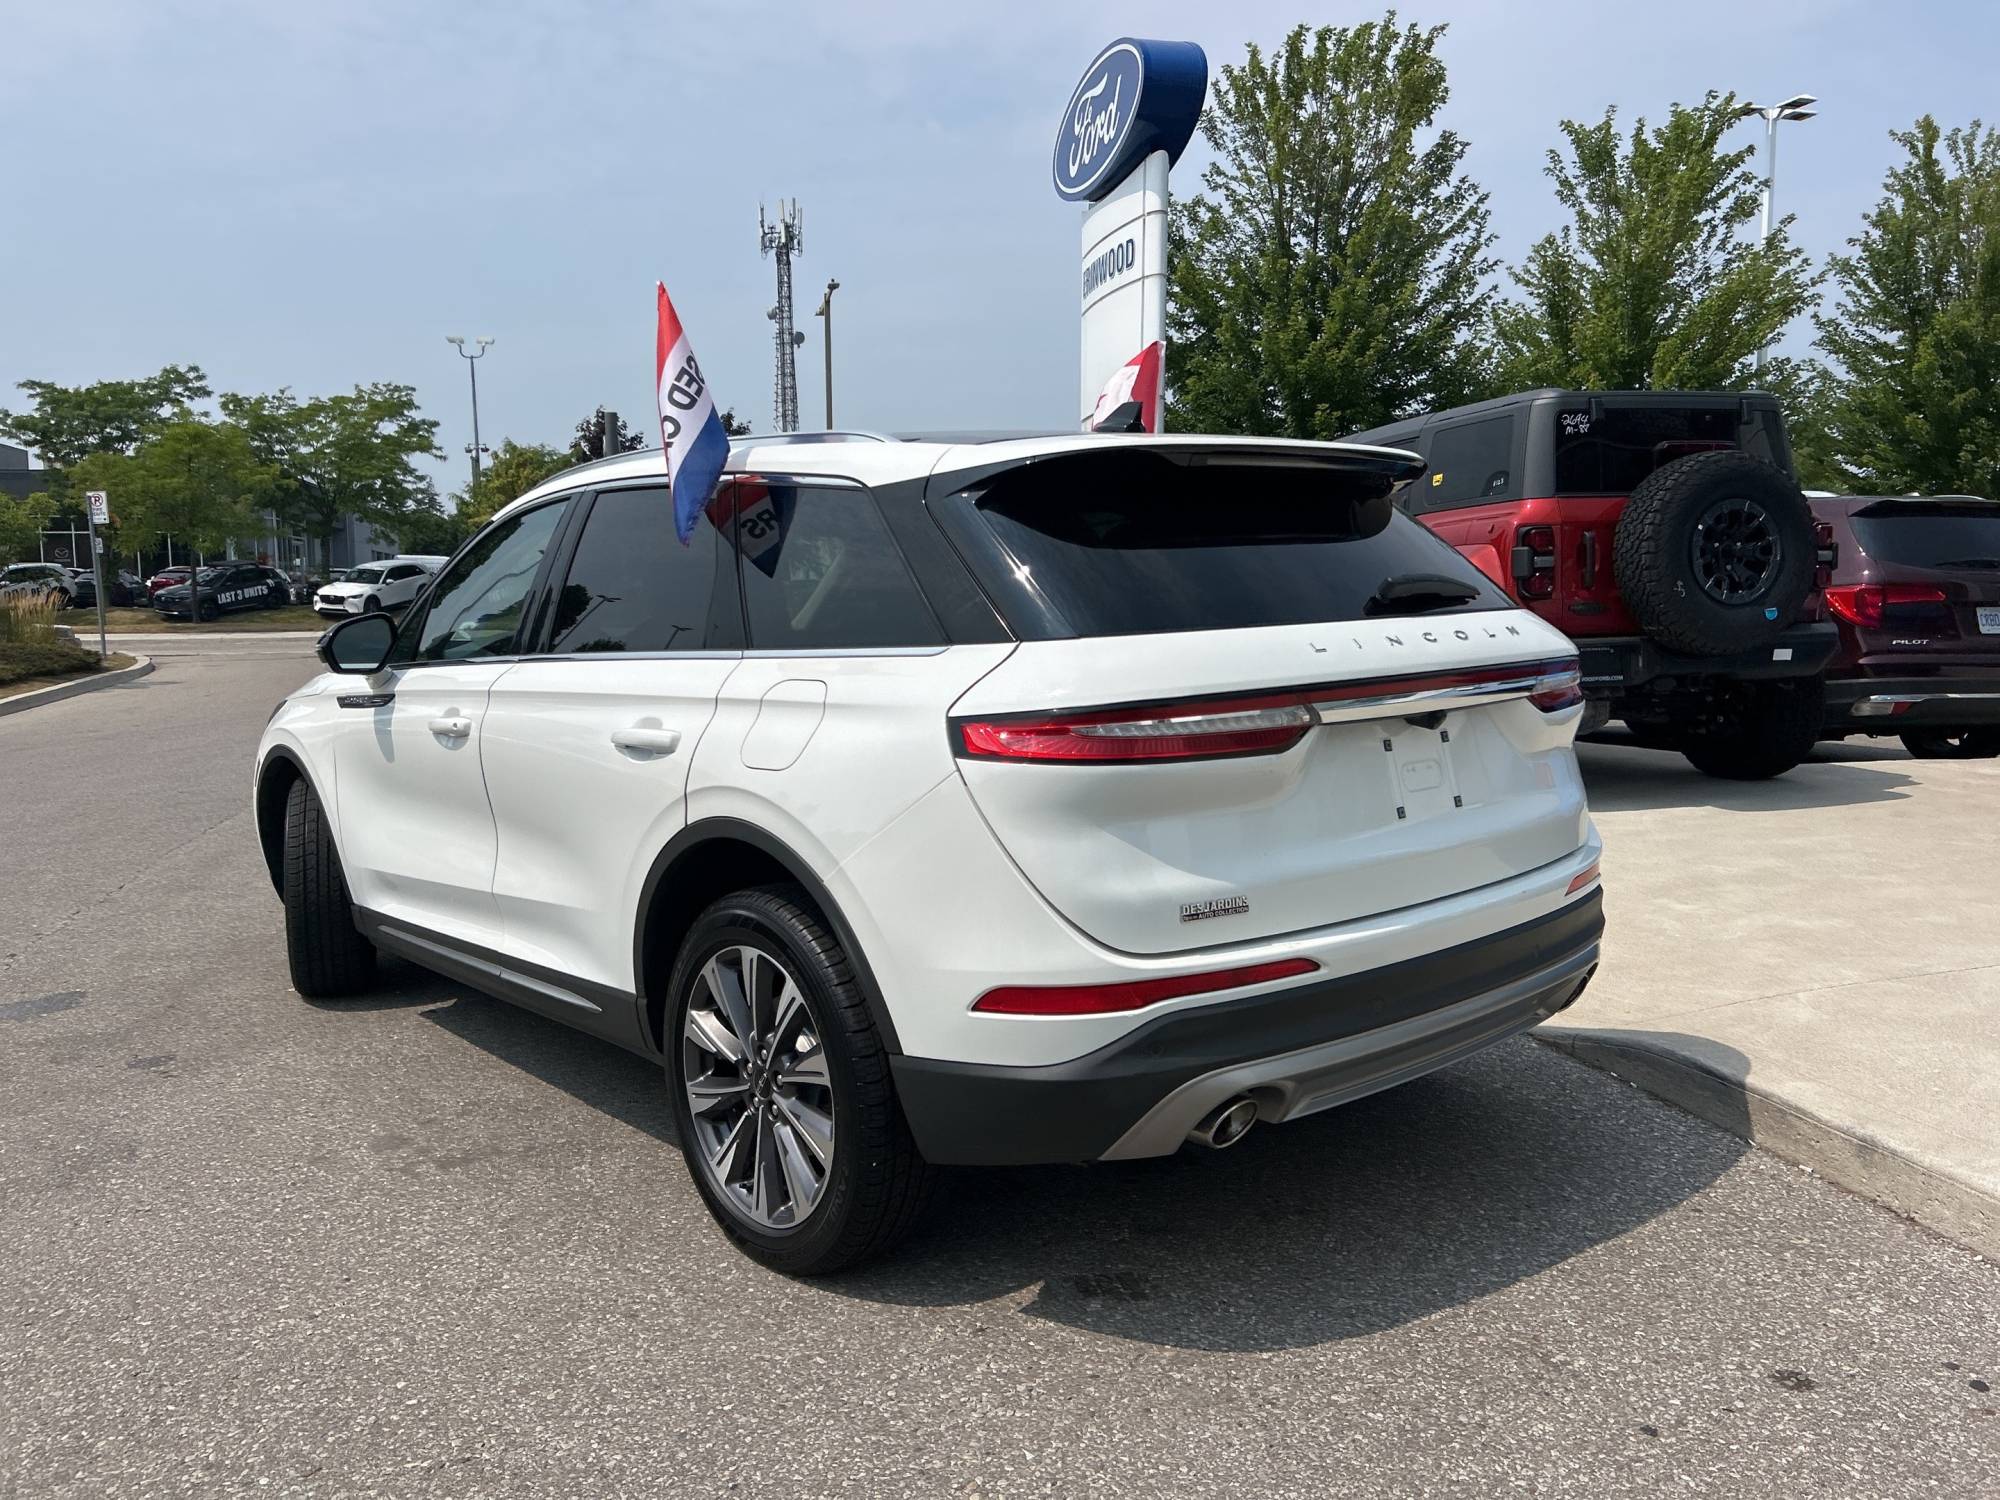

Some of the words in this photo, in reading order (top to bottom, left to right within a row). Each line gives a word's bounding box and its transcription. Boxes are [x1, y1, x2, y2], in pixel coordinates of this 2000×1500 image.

[1069, 72, 1122, 178] Ford
[217, 590, 236, 605] LAST
[236, 589, 243, 600] 3
[1310, 625, 1521, 653] LINCOLN
[1183, 895, 1249, 915] DESJARDINS
[1214, 906, 1249, 916] COLLECTION
